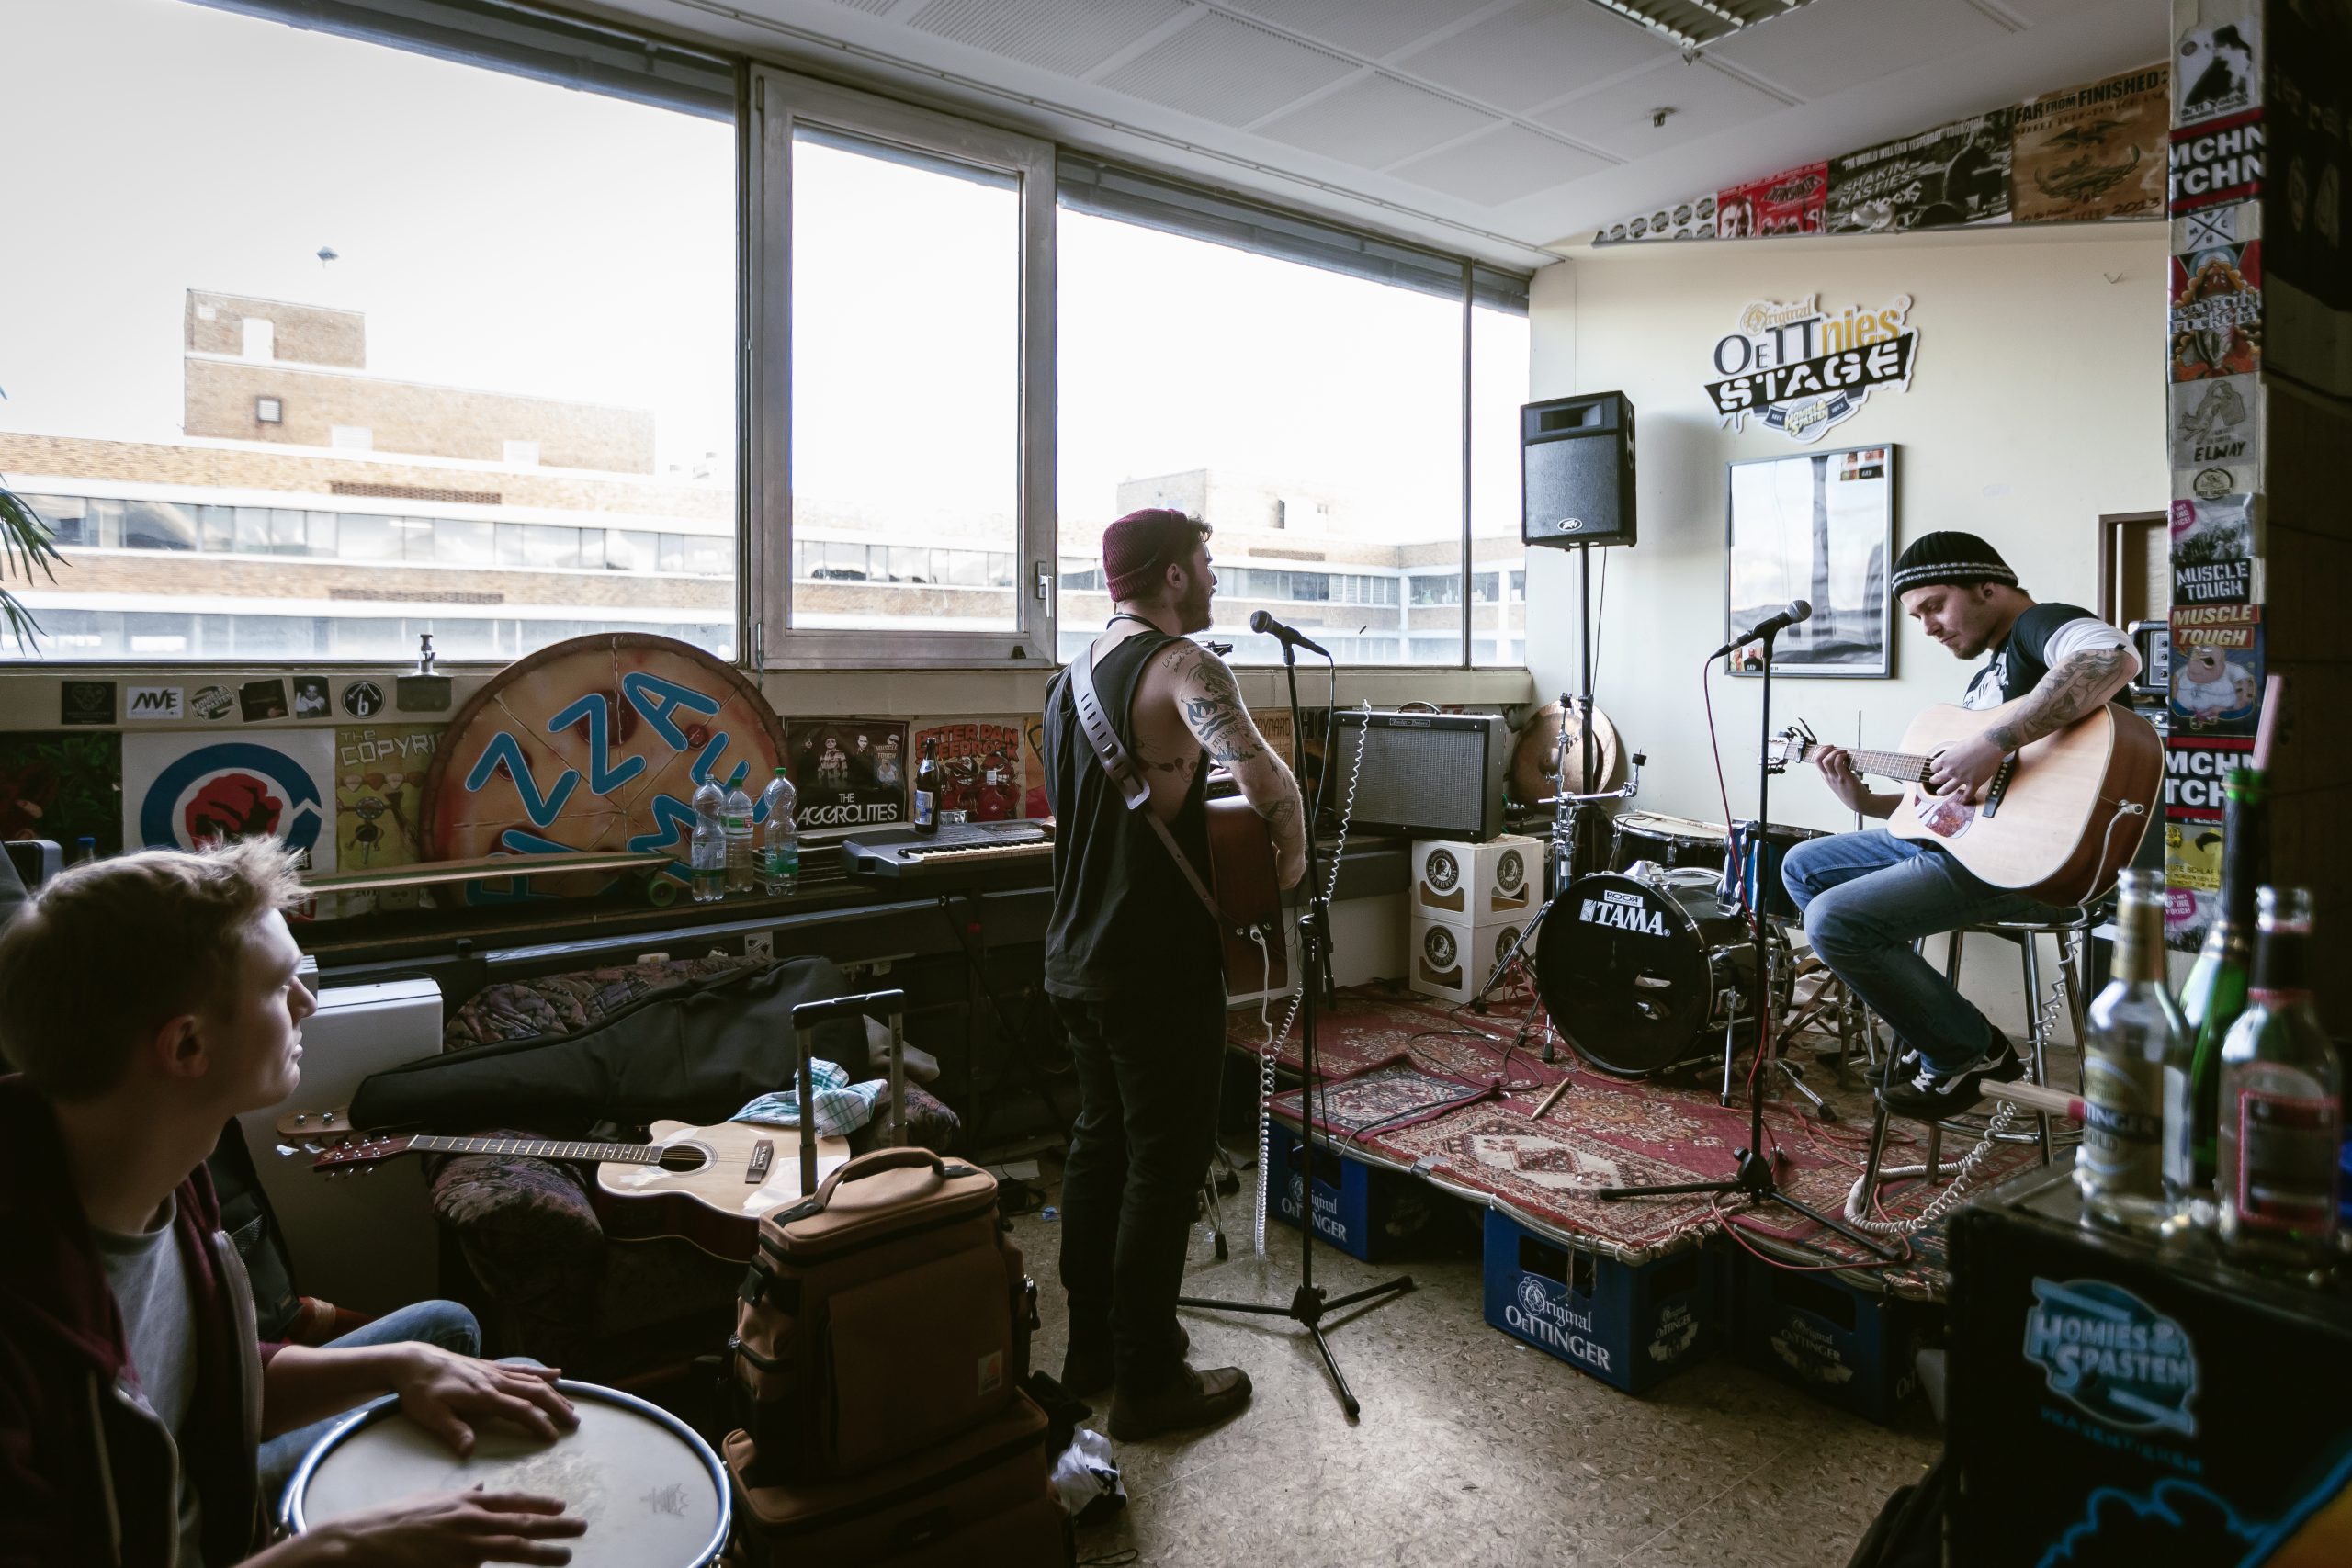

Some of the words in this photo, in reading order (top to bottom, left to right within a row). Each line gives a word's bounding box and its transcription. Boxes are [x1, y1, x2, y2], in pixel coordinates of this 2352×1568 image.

[2015, 102, 2043, 125] FAR
[2045, 96, 2076, 112] FROM
[1741, 299, 1813, 335] Original
[1719, 341, 1899, 410] STAGE
[2194, 441, 2246, 462] ELWAY
[2176, 561, 2248, 587] MUSCLE
[2184, 580, 2245, 601] TOUGH
[2172, 604, 2253, 626] MUSCLE
[2178, 629, 2247, 646] TOUGH
[340, 729, 376, 742] THE
[915, 724, 978, 750] PETER
[980, 724, 1019, 747] PAN
[839, 793, 854, 803] THE
[797, 803, 898, 826] AGGROLITES
[1595, 901, 1664, 936] TAMA
[1288, 1173, 1338, 1214] Oiginal
[1518, 1275, 1592, 1333] Original
[2029, 1311, 2148, 1359] HOMIES
[2052, 1342, 2188, 1389] SPASTEN
